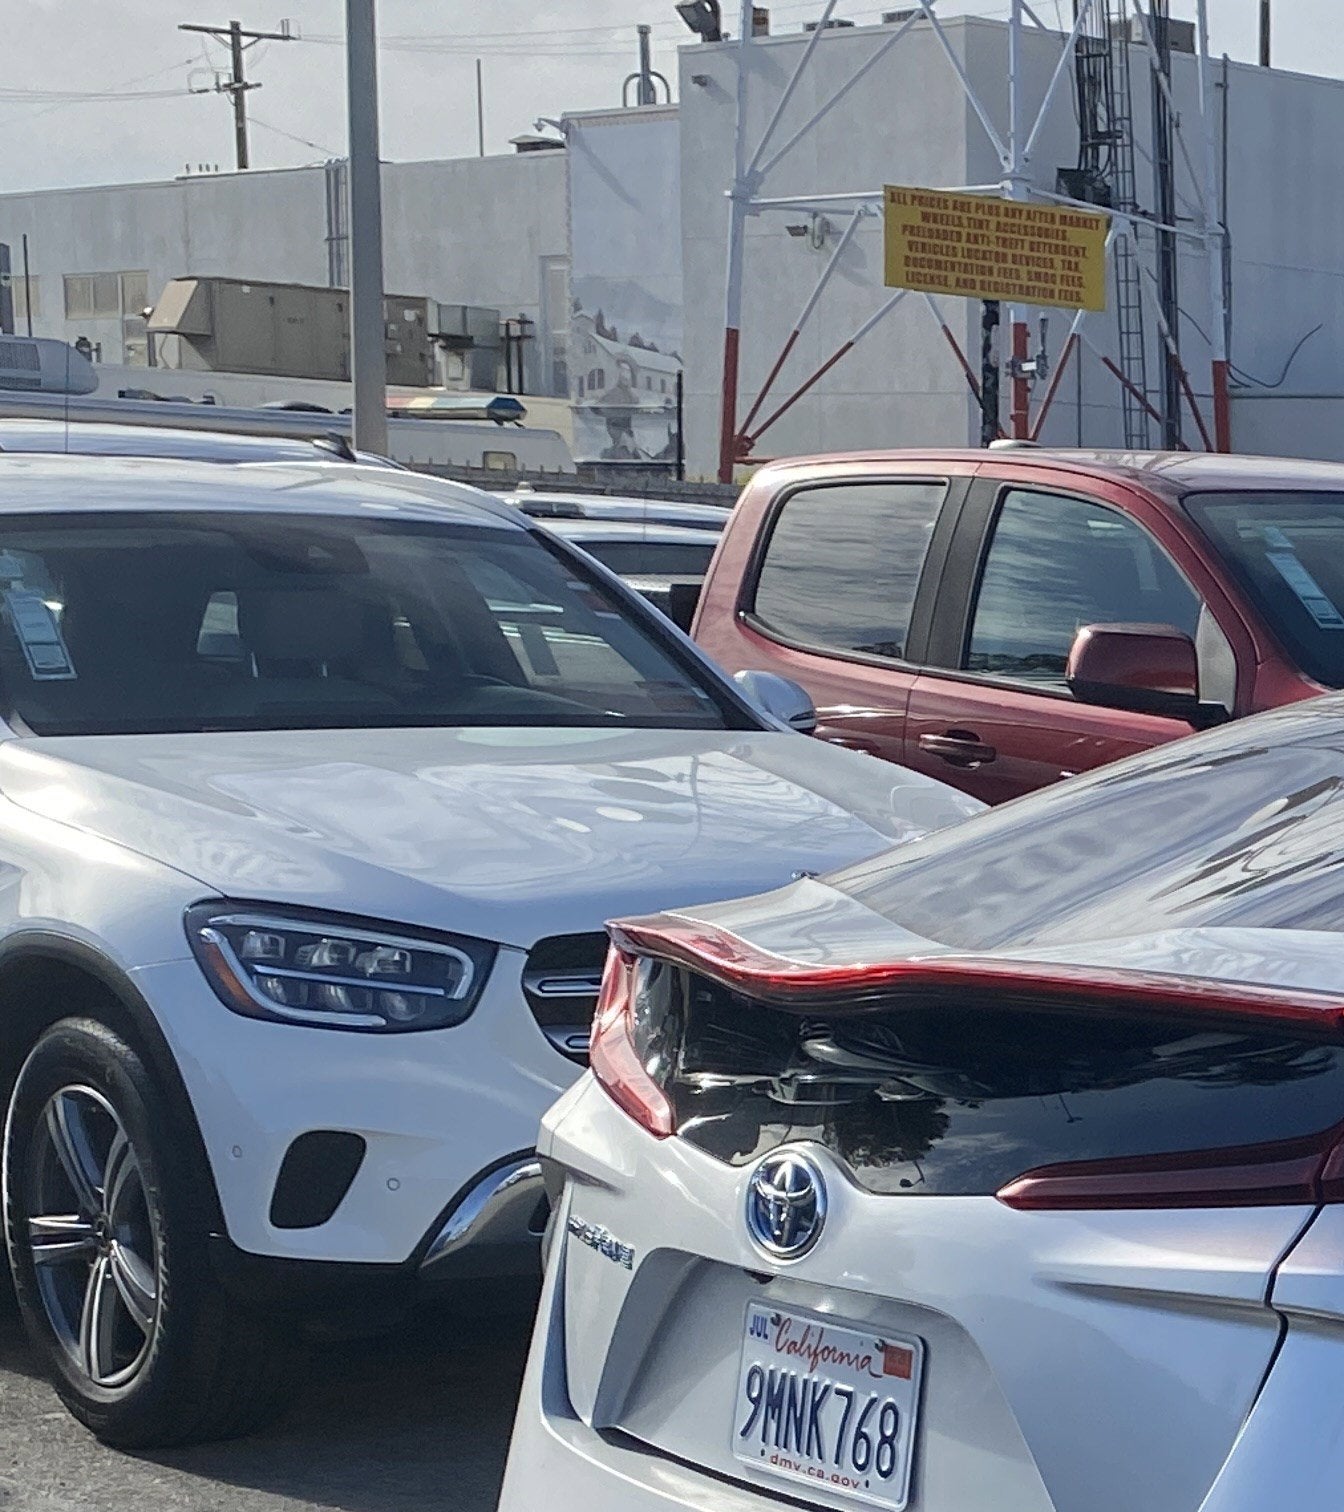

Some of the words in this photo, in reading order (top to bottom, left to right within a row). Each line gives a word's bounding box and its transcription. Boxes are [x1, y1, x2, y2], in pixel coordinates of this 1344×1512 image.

[750, 1313, 769, 1340] JUL
[774, 1317, 884, 1379] California
[740, 1363, 900, 1480] 9MNK768
[769, 1452, 861, 1490] dmv.ca.gov
